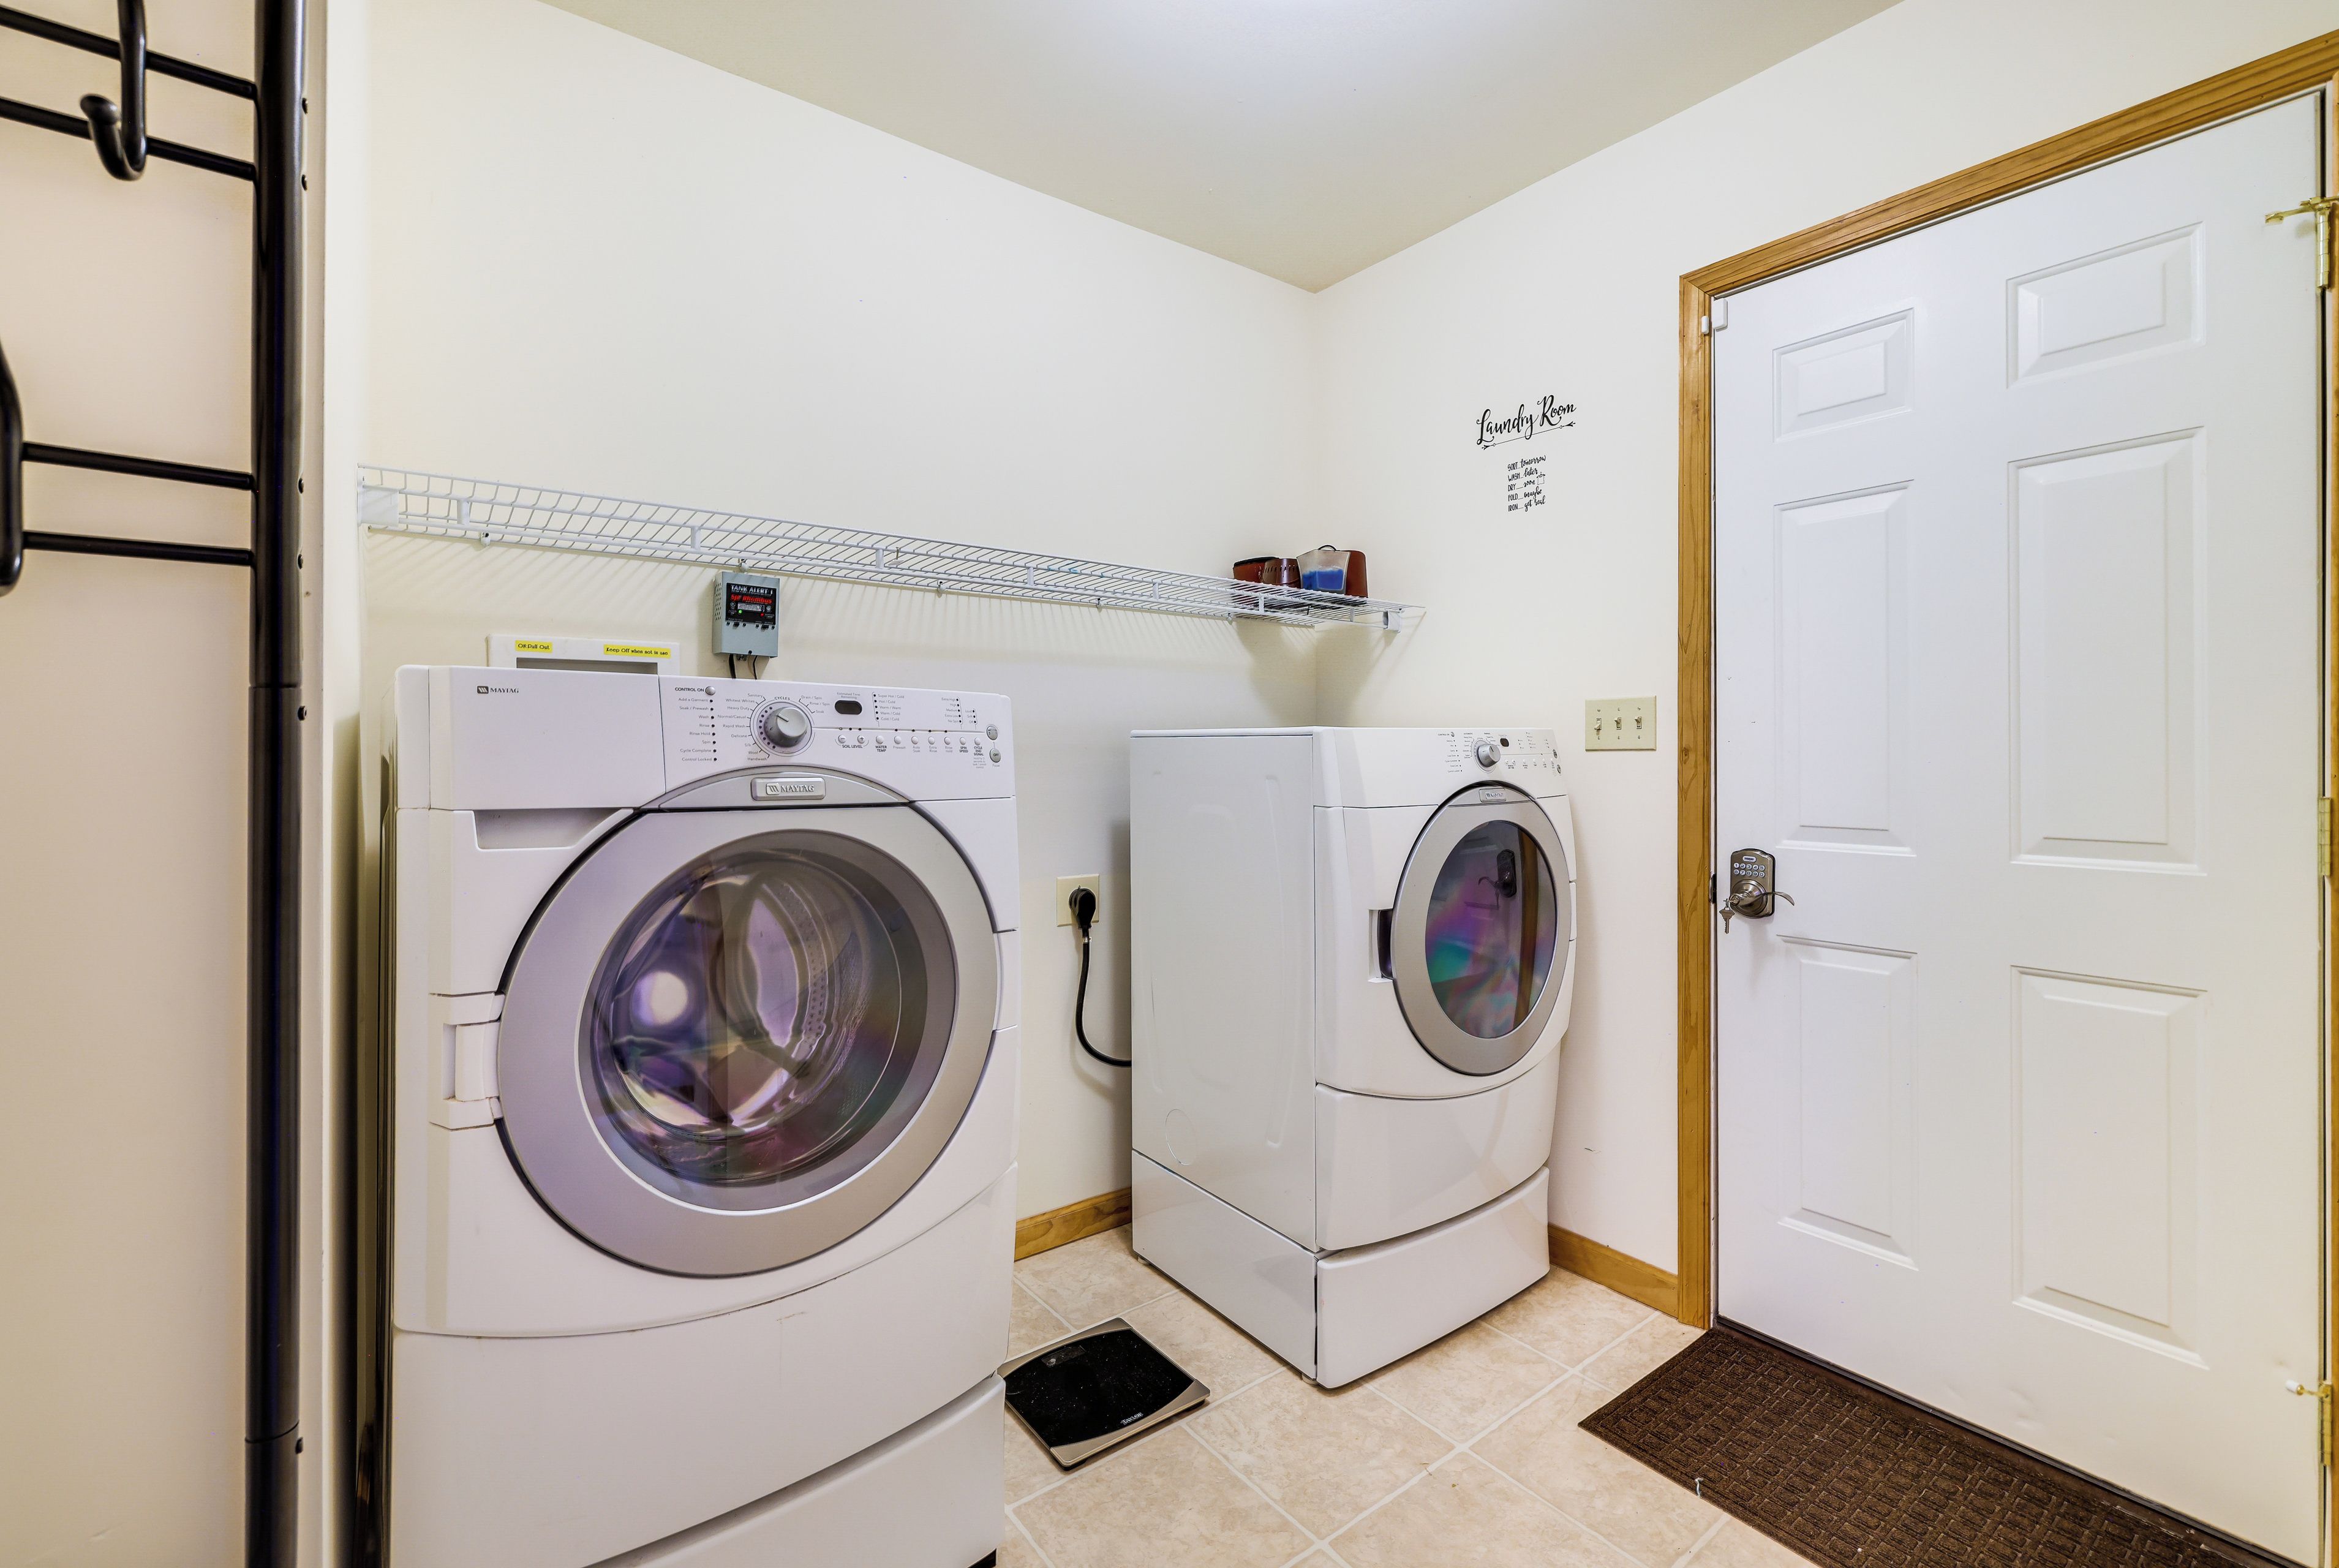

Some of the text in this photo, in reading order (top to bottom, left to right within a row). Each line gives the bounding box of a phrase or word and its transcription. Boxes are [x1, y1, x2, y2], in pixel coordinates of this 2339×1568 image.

[1477, 395, 1576, 445] Laundry Room
[1524, 499, 1533, 512] get
[1534, 495, 1545, 505] real
[781, 784, 815, 793] MAYTAG
[1120, 1412, 1143, 1425] TAYLOR
